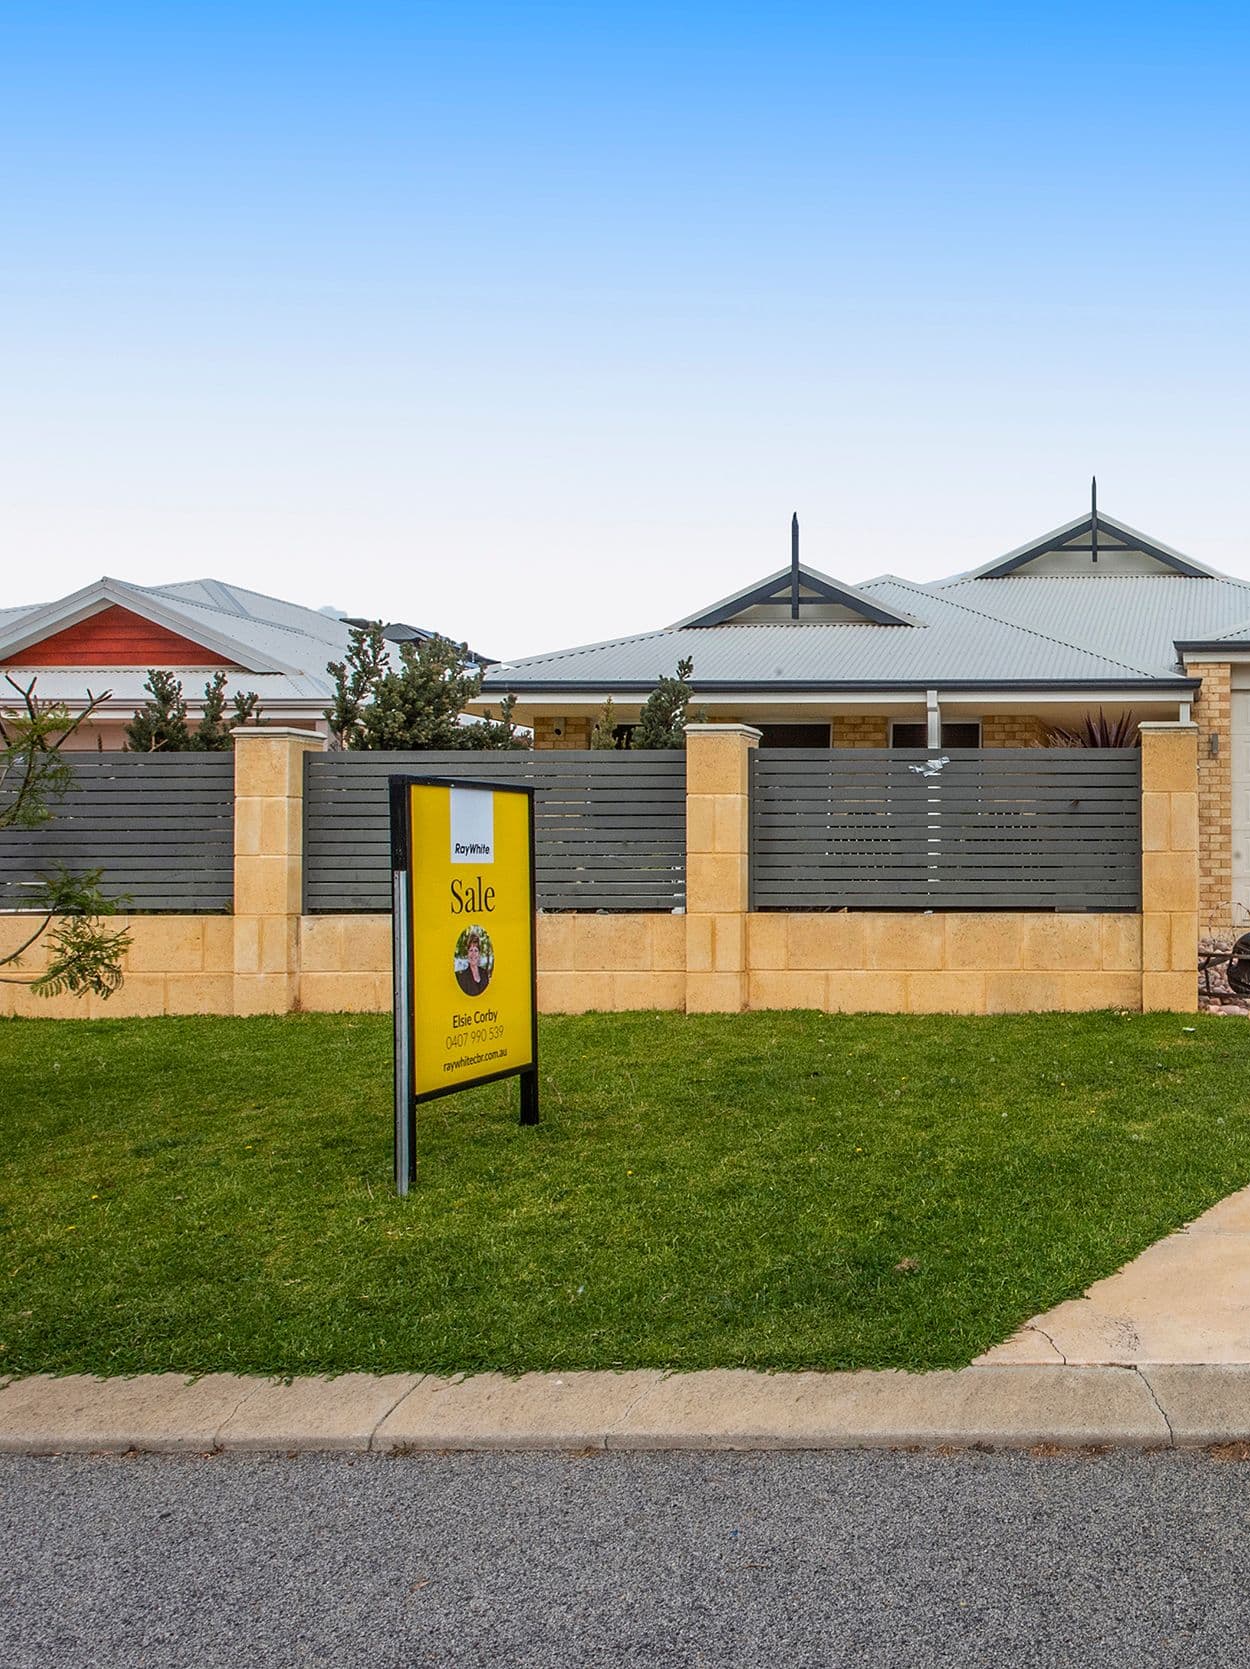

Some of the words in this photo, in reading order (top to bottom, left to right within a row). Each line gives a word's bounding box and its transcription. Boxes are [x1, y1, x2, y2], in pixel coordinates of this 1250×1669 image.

[451, 876, 496, 914] Sale
[452, 1013, 472, 1029] Elsie
[473, 1008, 498, 1024] Corby
[445, 1032, 468, 1050] 0407
[471, 1029, 487, 1044] 990
[489, 1025, 504, 1040] 539
[443, 1048, 508, 1073] raywhitecbr.com.au
